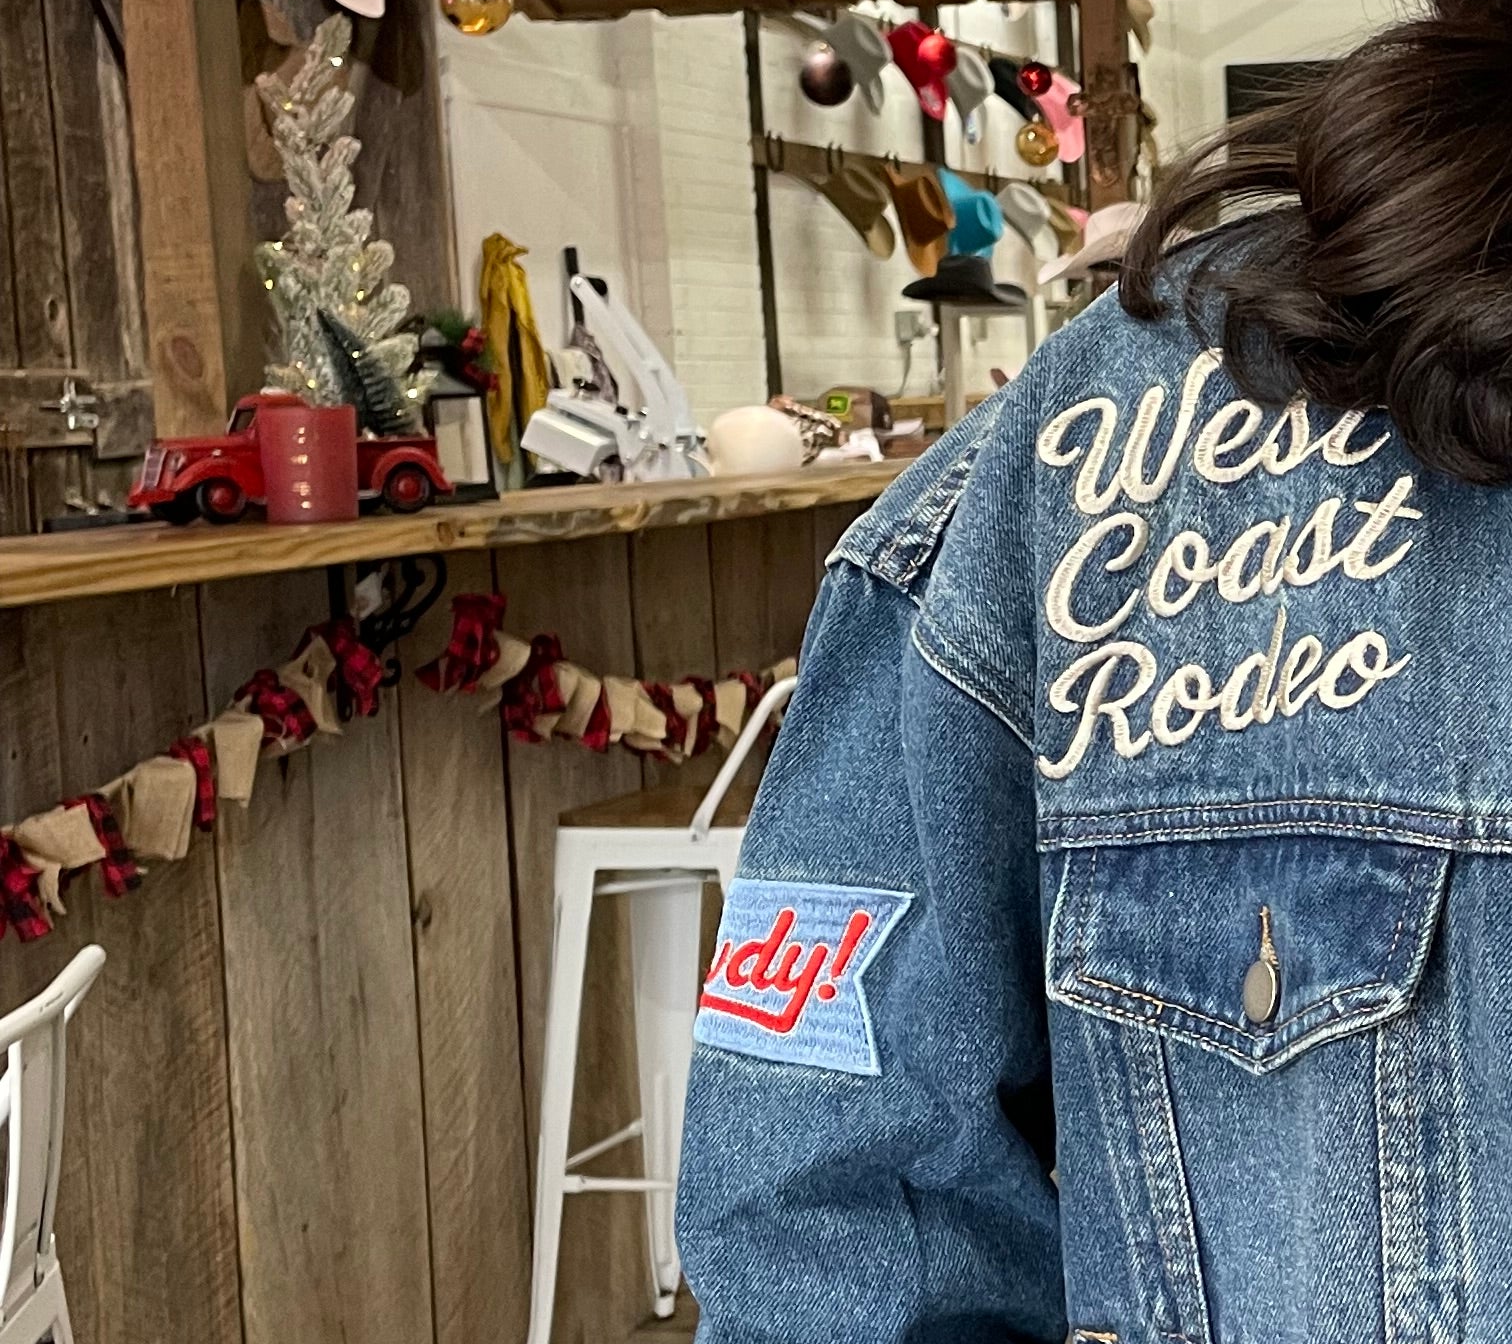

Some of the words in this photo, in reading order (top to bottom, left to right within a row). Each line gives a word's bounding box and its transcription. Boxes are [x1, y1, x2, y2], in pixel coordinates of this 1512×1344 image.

[1045, 475, 1423, 642] Coast
[1038, 606, 1412, 779] Rodeo
[700, 907, 871, 1035] dy!
